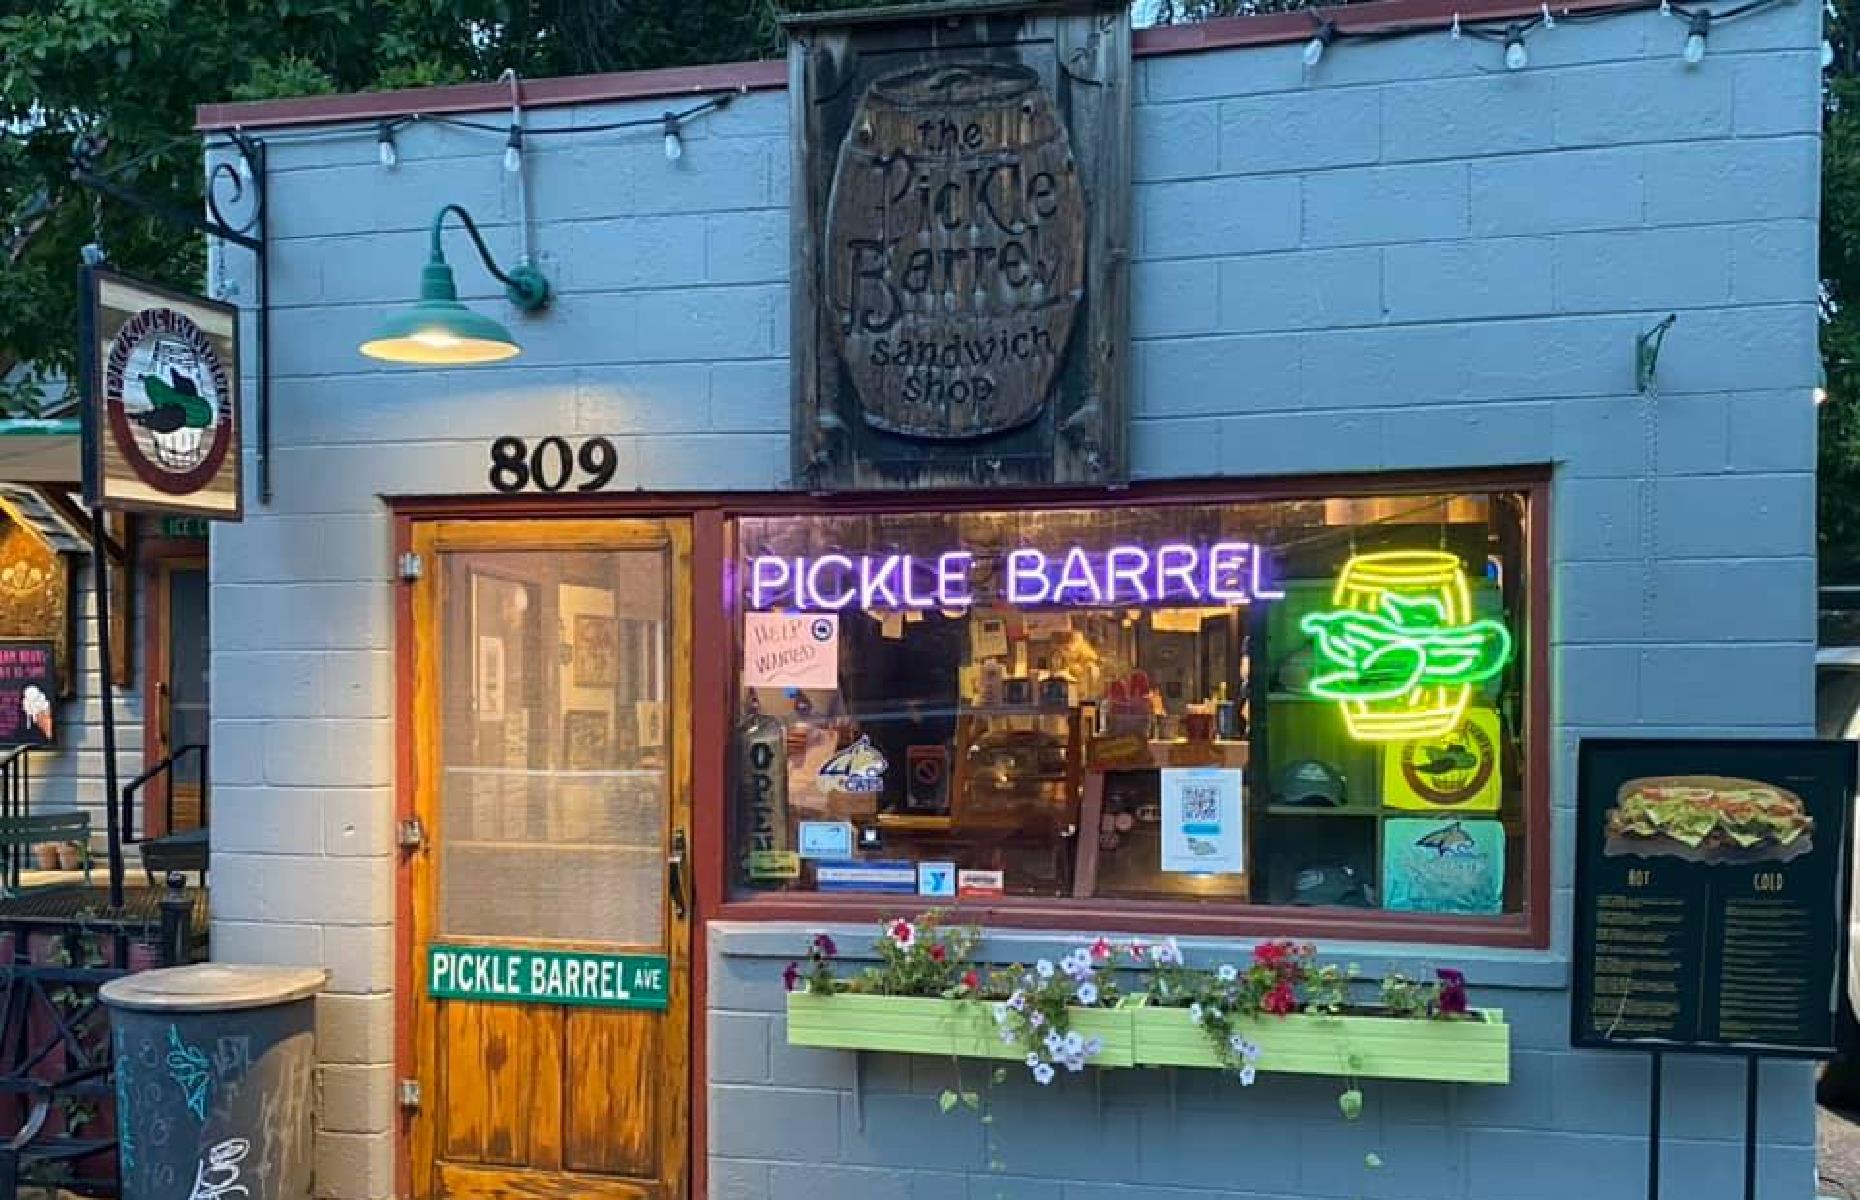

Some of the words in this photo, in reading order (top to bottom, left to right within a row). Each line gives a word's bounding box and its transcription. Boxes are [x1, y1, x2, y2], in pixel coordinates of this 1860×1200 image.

[918, 117, 984, 150] the
[871, 325, 1053, 369] sandwich
[903, 369, 993, 408] shop
[490, 435, 618, 493] 809
[751, 552, 973, 609] PICKLE
[1006, 542, 1286, 604] BARREL
[1628, 868, 1651, 886] HOT
[1753, 872, 1784, 891] COLD
[433, 953, 521, 994] PICKLE
[530, 957, 630, 1000] BARREL
[634, 968, 662, 990] AVE
